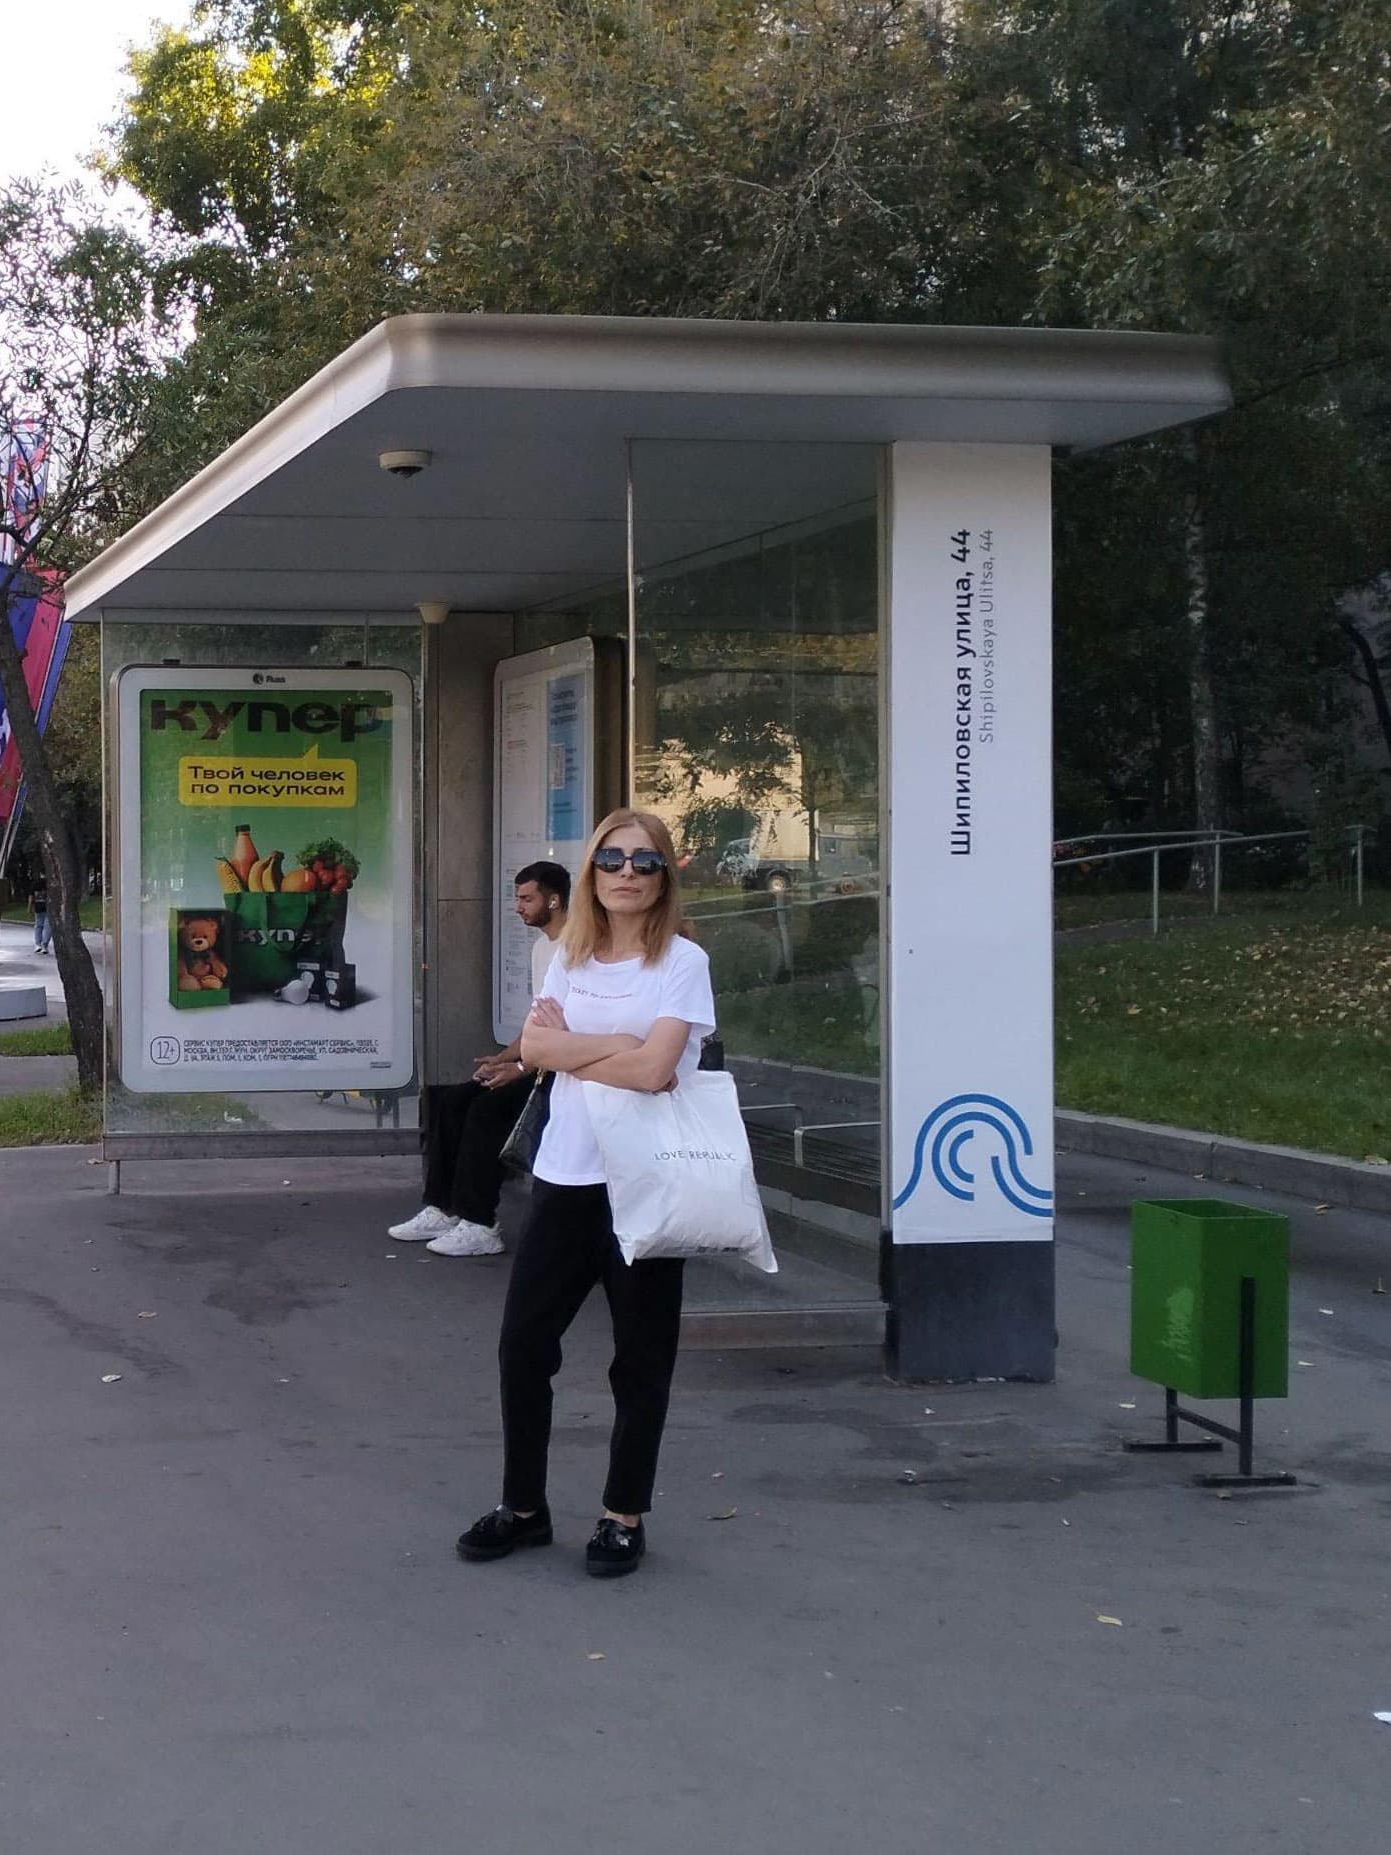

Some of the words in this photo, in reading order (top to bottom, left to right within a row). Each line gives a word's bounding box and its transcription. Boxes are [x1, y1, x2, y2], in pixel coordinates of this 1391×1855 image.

[950, 528, 971, 564] 44
[979, 528, 994, 551] 44
[979, 556, 996, 614] Ulitsa,
[954, 571, 976, 660] улица,
[979, 620, 997, 744] Shipilovskaya
[188, 766, 244, 780] Твой
[252, 768, 346, 781] человек
[950, 667, 972, 857] Шипиловская
[191, 784, 219, 794] по
[228, 784, 345, 798] покупкам
[157, 1041, 176, 1060] 12+
[653, 1151, 687, 1161] LOVE
